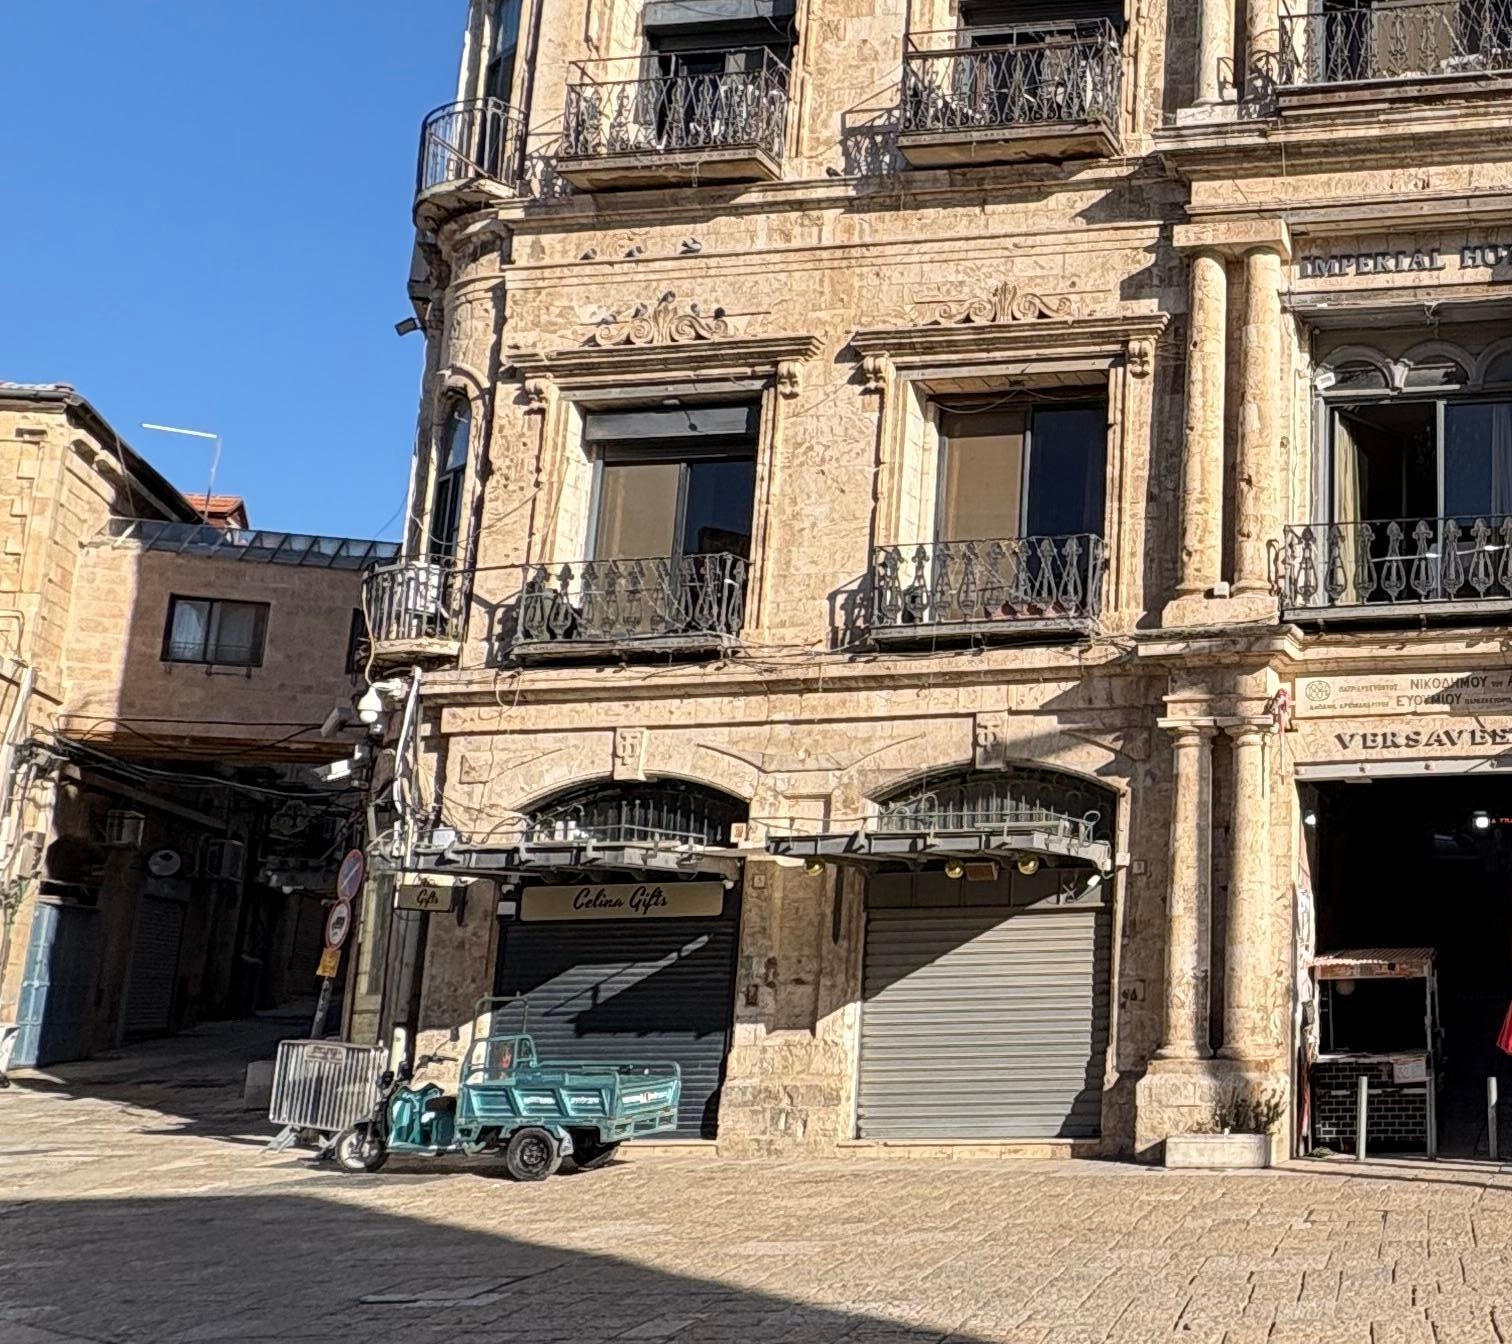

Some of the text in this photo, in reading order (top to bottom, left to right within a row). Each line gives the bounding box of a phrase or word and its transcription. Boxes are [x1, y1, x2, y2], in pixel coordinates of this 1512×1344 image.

[1300, 248, 1446, 278] IMPERIAL
[1334, 728, 1511, 750] VERSAVEE
[573, 885, 668, 915] Celina Gifts
